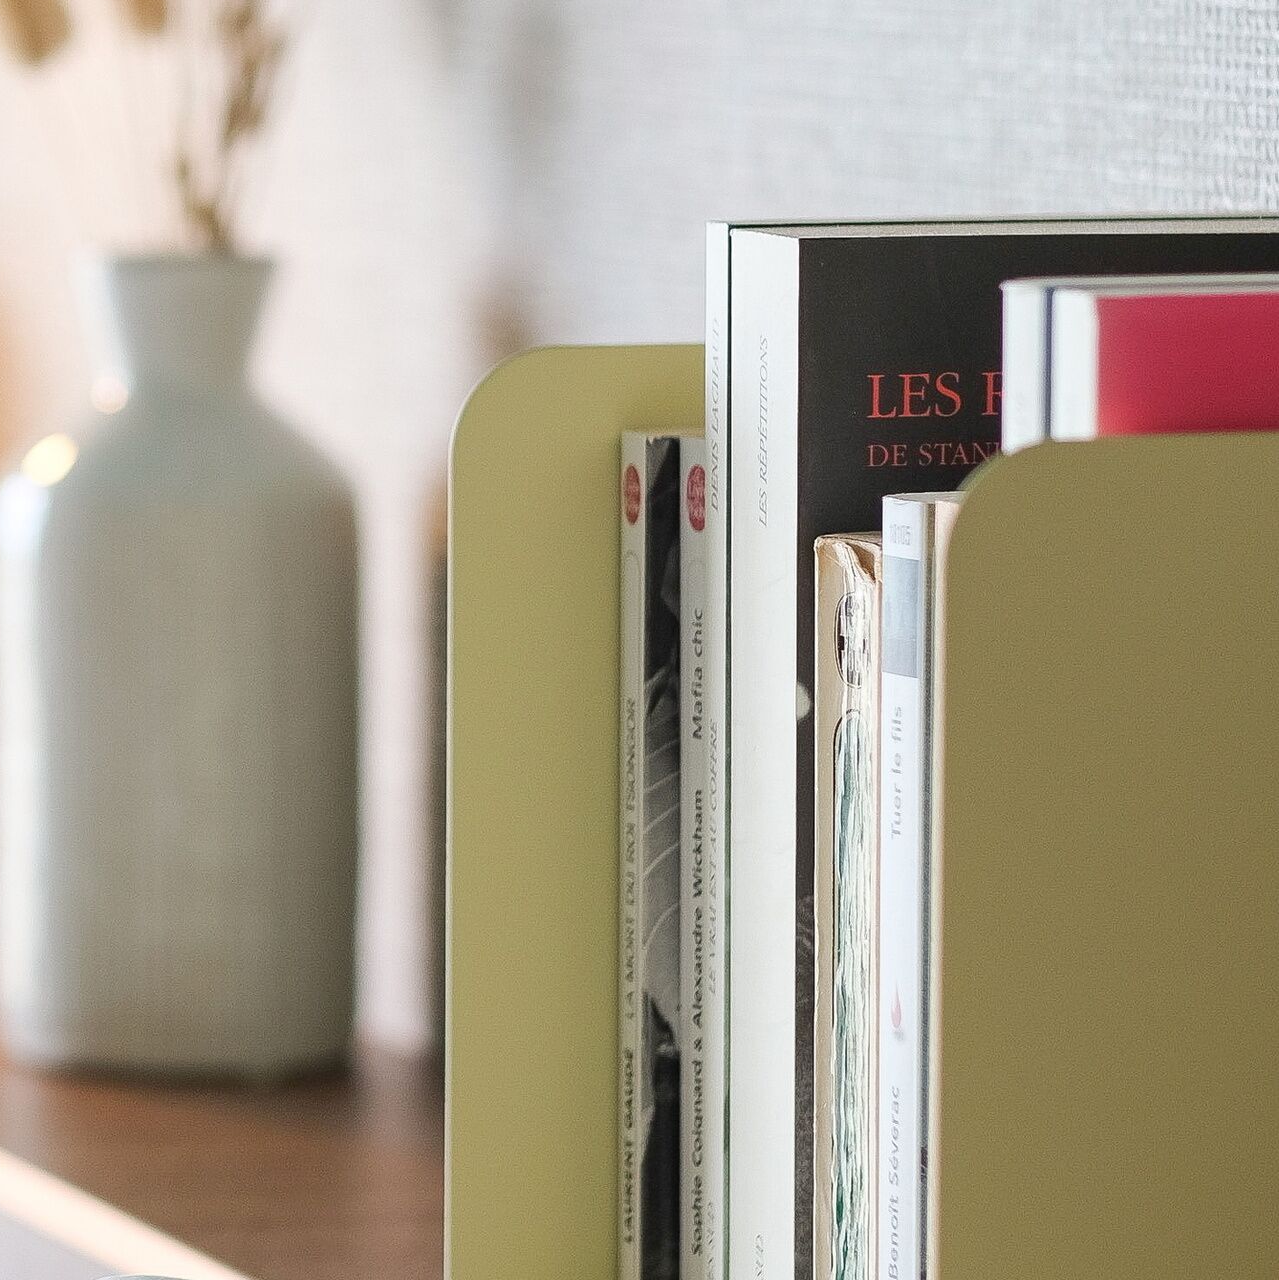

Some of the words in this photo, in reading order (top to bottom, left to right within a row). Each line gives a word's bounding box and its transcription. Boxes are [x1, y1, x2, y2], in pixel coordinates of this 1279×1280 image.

[757, 335, 768, 484] RÉPÉTITIONS
[866, 372, 964, 418] LES
[710, 440, 720, 511] DENIS
[867, 444, 908, 467] DE
[758, 488, 768, 527] LES
[691, 608, 704, 658] chic
[691, 667, 704, 740] Mafia
[890, 706, 903, 743] fils
[890, 752, 902, 775] le
[691, 789, 703, 899] Wickham
[890, 783, 902, 840] Tuer
[691, 907, 703, 1030] Alexandre
[691, 1037, 703, 1053] &
[691, 1060, 704, 1167] Coignard
[887, 1086, 900, 1186] Séverac
[691, 1176, 704, 1256] Sophie
[887, 1196, 900, 1280] Benoît
